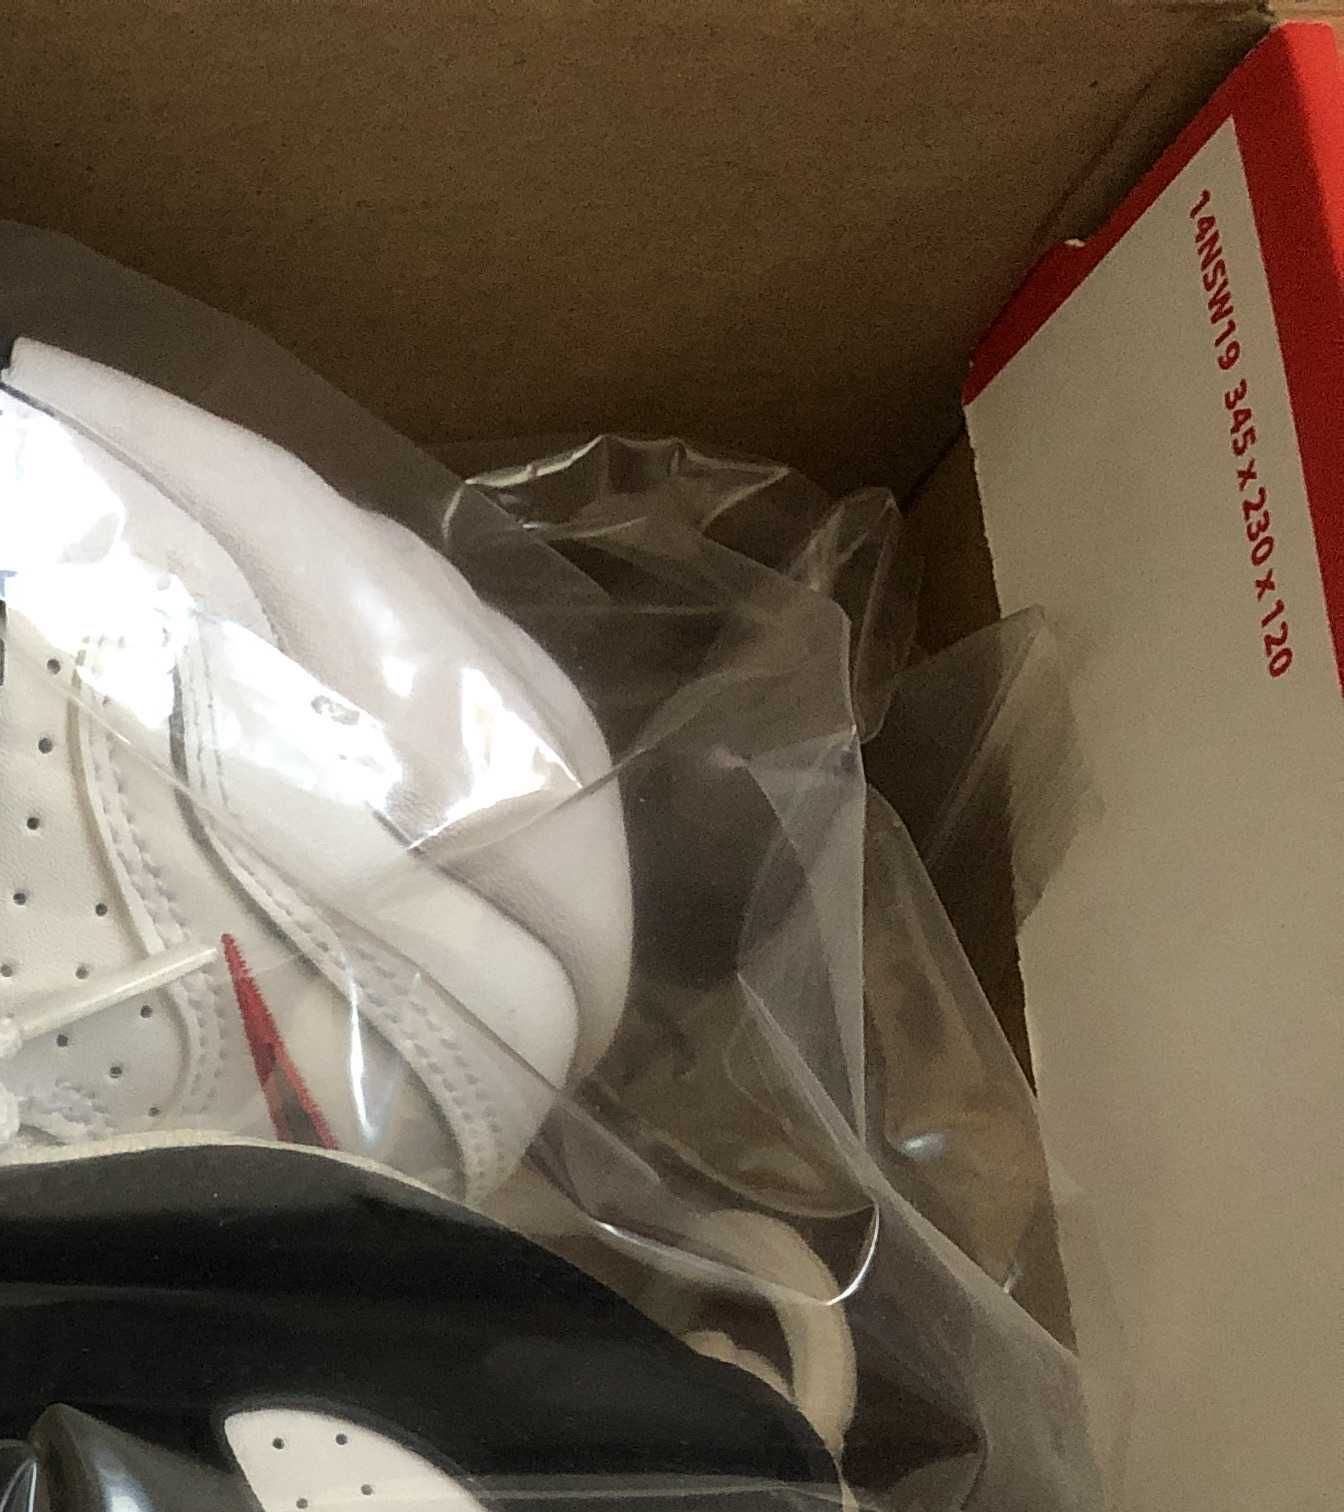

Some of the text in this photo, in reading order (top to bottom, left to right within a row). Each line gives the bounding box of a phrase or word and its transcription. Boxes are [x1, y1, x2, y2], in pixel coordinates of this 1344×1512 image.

[1188, 188, 1241, 371] 14NSW19
[1224, 377, 1257, 457] 345
[1242, 486, 1275, 567] 230
[1260, 598, 1294, 679] 120
